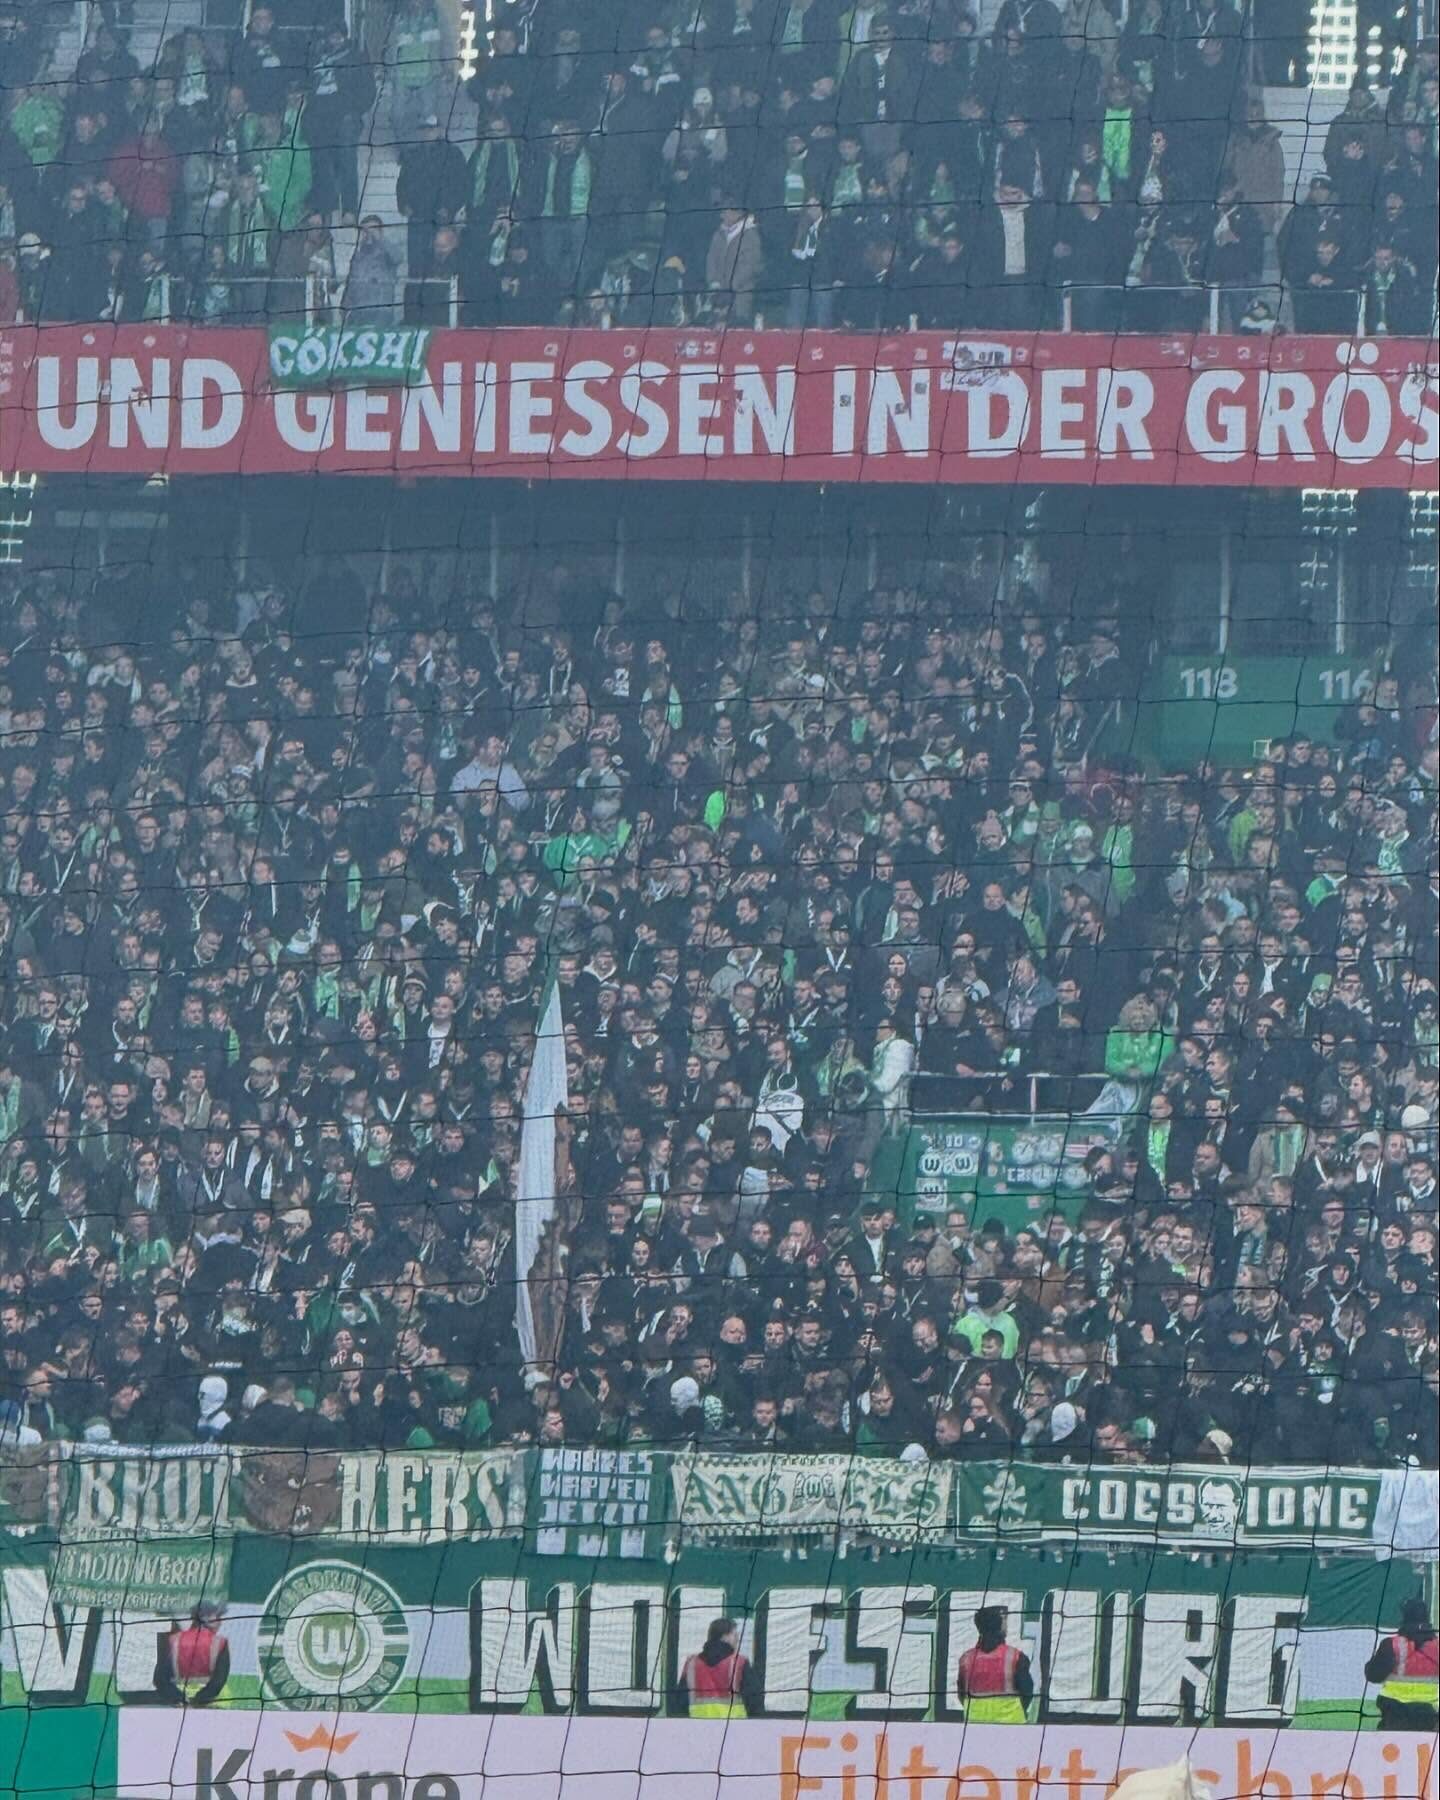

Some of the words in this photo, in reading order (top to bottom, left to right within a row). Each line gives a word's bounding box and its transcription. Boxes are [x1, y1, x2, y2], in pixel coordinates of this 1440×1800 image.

[36, 356, 243, 450] UND
[273, 361, 796, 459] GENIESSEN
[831, 365, 930, 457] IN
[966, 367, 1154, 460] DER
[1180, 667, 1238, 699] 118
[1318, 669, 1373, 700] 116
[196, 1748, 461, 1800] Krone
[780, 1732, 1432, 1800] Filterthni
